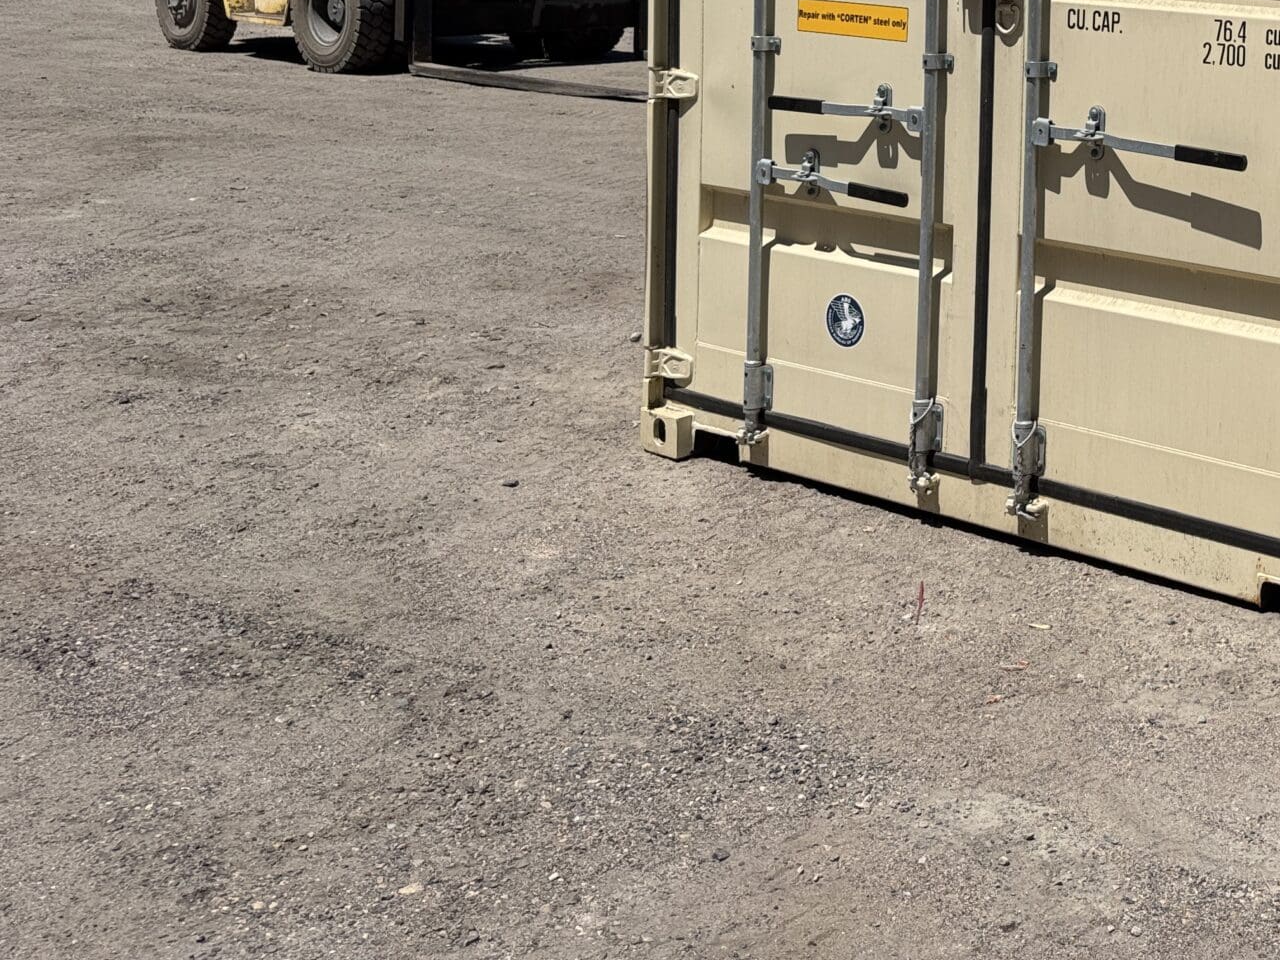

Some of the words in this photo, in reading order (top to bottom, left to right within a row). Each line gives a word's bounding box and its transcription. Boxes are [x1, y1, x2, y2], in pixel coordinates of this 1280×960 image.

[798, 9, 819, 21] Repair
[821, 12, 836, 21] with
[873, 18, 890, 27] steel
[891, 19, 907, 30] only
[1214, 19, 1247, 44] 76.4
